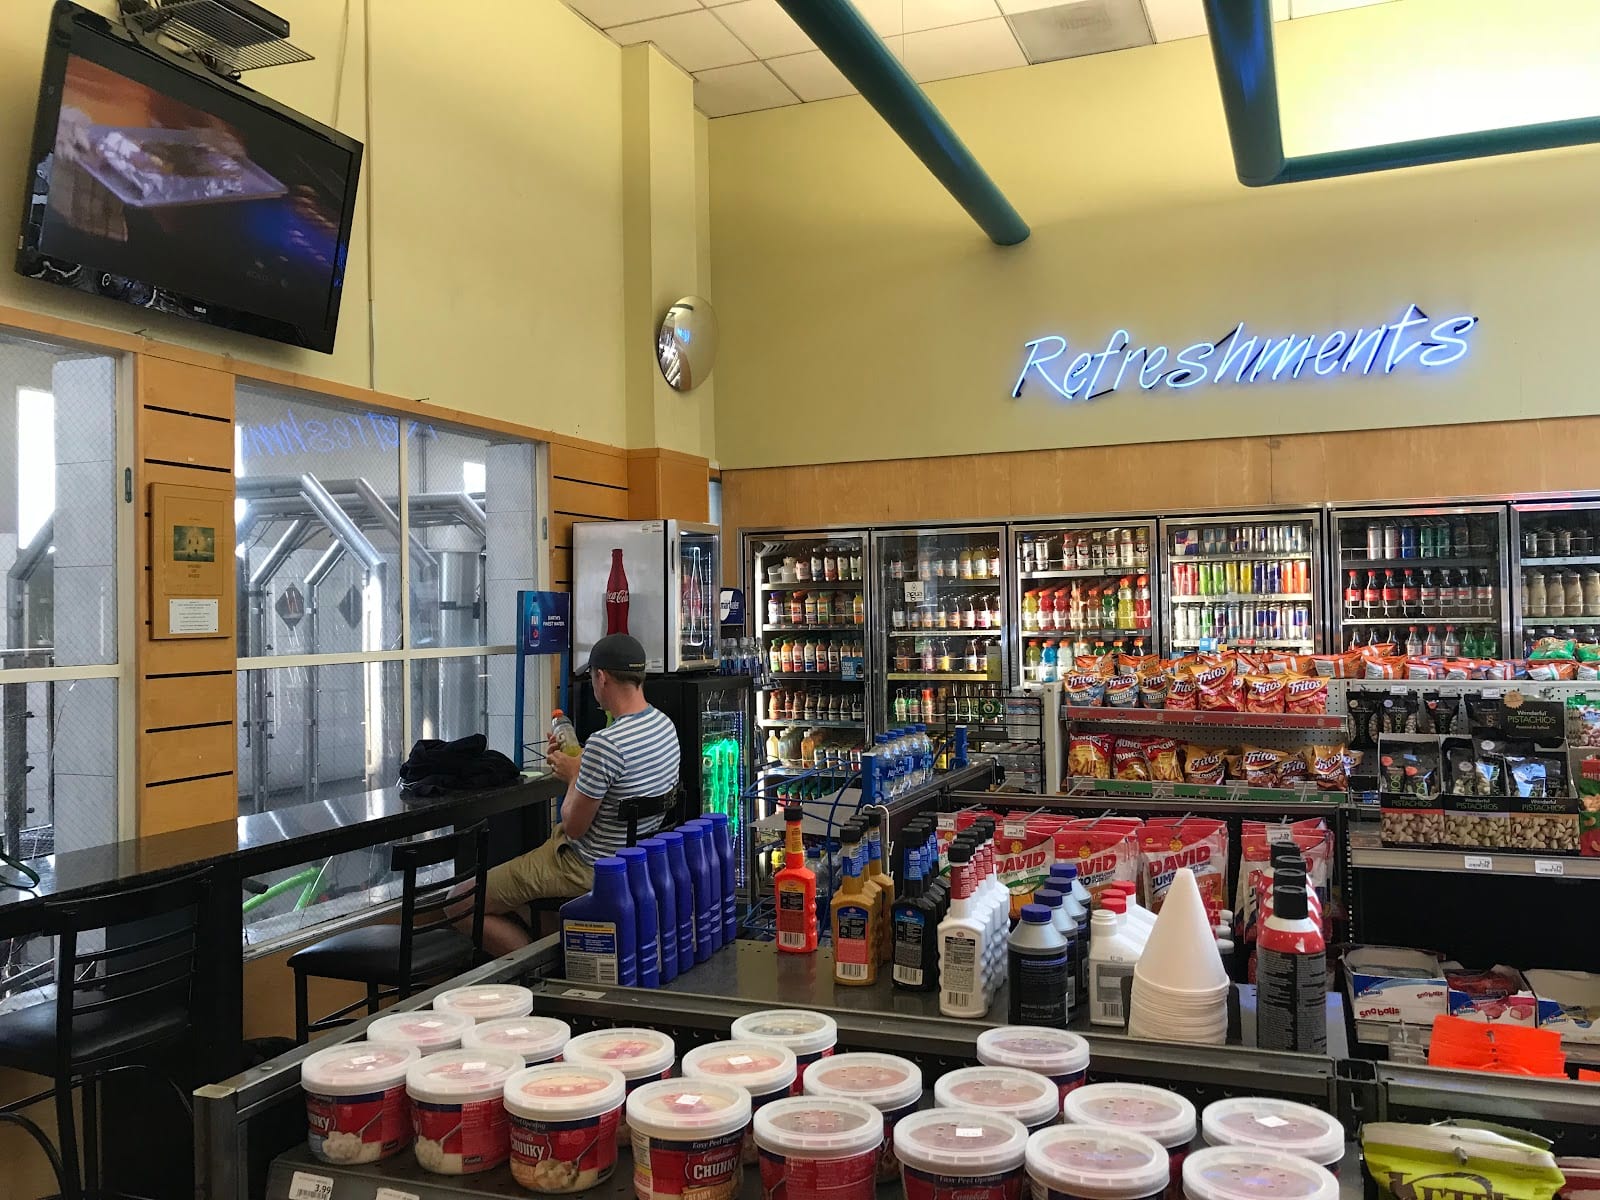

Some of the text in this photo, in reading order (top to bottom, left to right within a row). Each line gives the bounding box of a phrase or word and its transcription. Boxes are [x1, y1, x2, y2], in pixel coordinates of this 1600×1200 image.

[1012, 304, 1477, 399] Refreshments
[1143, 674, 1167, 688] Frito
[1197, 665, 1227, 685] Fritos
[1252, 680, 1281, 694] Fritos
[1288, 679, 1321, 694] Fritos
[1507, 715, 1557, 724] PISTACHIOS
[1246, 750, 1279, 764] Fritos
[1281, 760, 1307, 774] Frito
[1456, 802, 1499, 811] PISTACHIOS
[994, 851, 1046, 875] DAVID
[1075, 854, 1118, 877] AVID
[1148, 845, 1211, 877] DAVID
[1151, 872, 1178, 889] JUM
[693, 1157, 739, 1180] CHUNKY
[315, 1184, 331, 1194] 3.99
